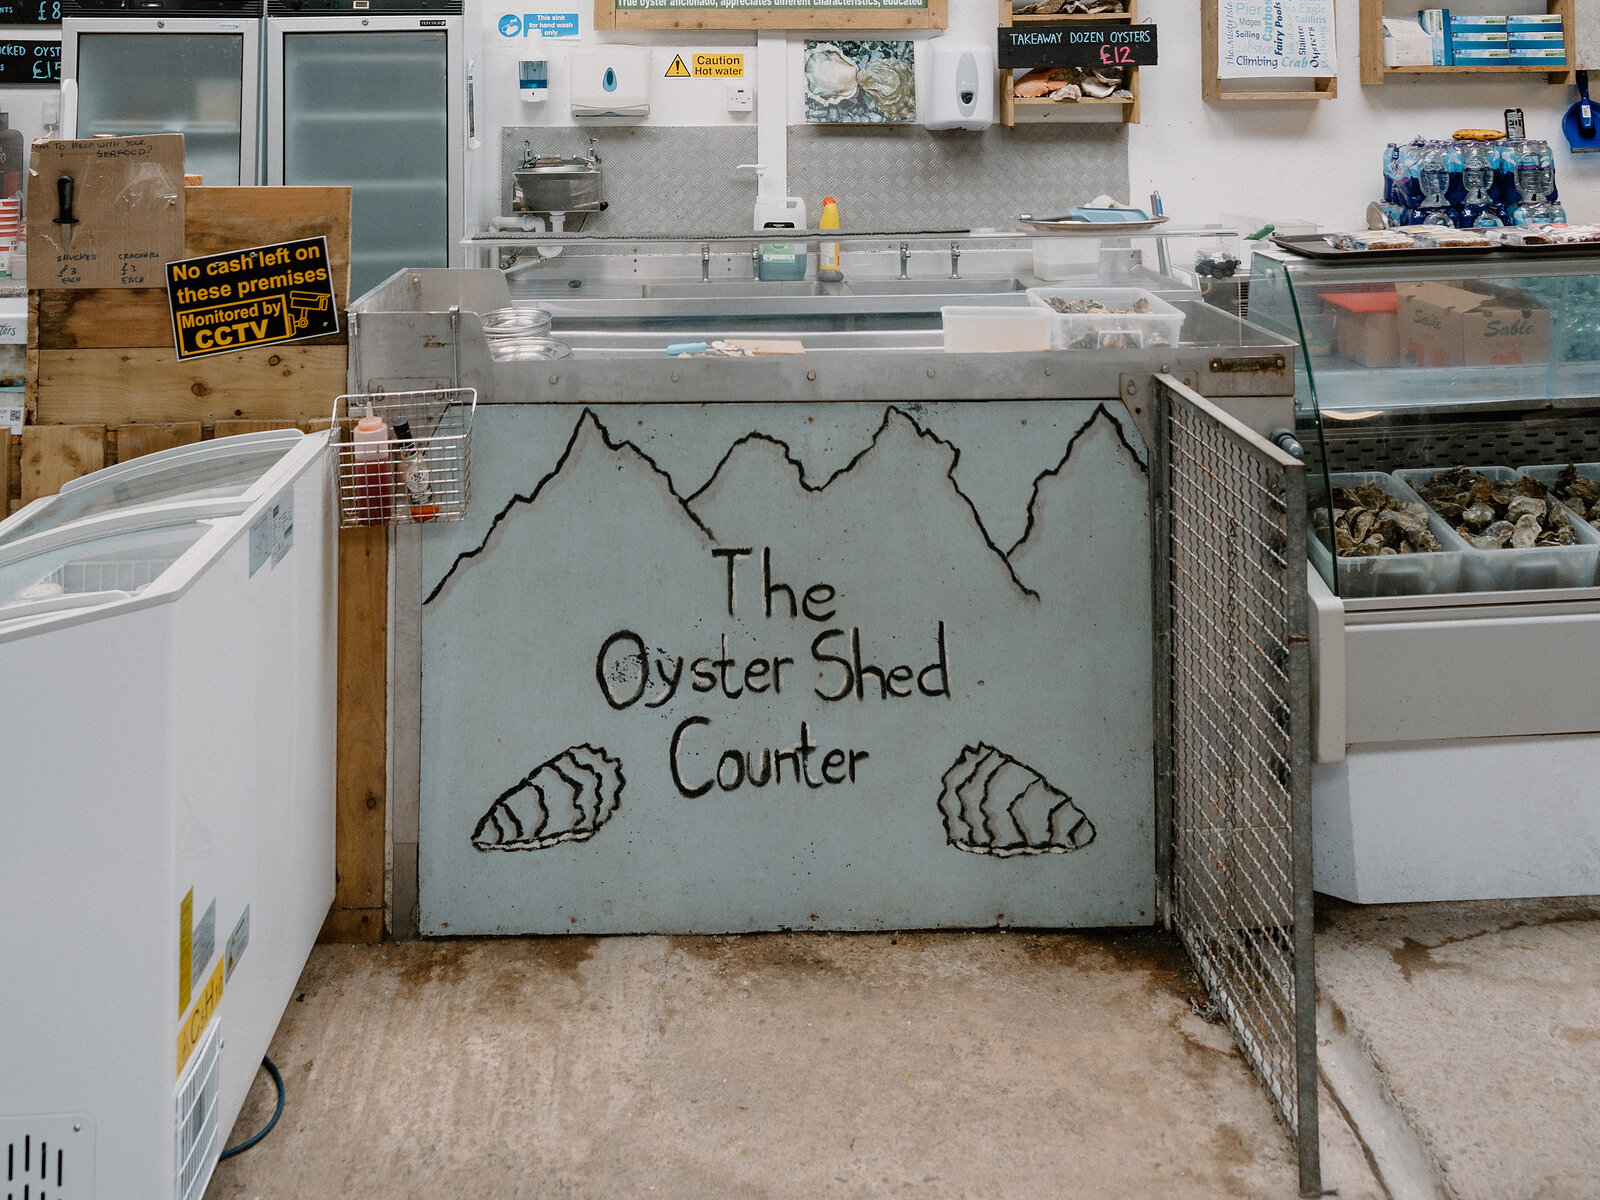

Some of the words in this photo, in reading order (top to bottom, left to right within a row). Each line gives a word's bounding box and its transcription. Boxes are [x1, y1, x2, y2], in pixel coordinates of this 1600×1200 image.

[1235, 2, 1262, 16] Pier
[1273, 1, 1283, 28] Pools
[1239, 18, 1261, 27] Midges
[1009, 32, 1062, 46] TAKEAWAY
[1070, 31, 1104, 44] DOZEN
[1110, 30, 1151, 43] OYSTERS
[1235, 29, 1260, 40] Sailing
[1274, 30, 1285, 56] Fairy
[1100, 44, 1135, 65] £12
[1307, 26, 1320, 68] Oysters
[697, 55, 740, 65] Caution
[1236, 55, 1278, 69] Climbing
[1281, 56, 1309, 69] Crab
[695, 67, 712, 75] Hot
[715, 67, 743, 75] water
[54, 143, 65, 151] TO
[97, 141, 120, 149] WITH
[172, 263, 201, 282] No
[206, 254, 254, 276] cash
[259, 247, 291, 268] left
[295, 245, 320, 261] on
[61, 276, 81, 284] EACH
[121, 276, 144, 284] EACH
[176, 283, 232, 304] these
[237, 267, 327, 298] premises
[181, 302, 259, 329] Monitored
[262, 301, 281, 318] by
[195, 318, 269, 349] CCTV
[1484, 319, 1535, 337] Sable
[711, 546, 837, 623] The
[595, 628, 794, 711] Oyster
[810, 619, 952, 702] Shed
[669, 715, 870, 800] Counter
